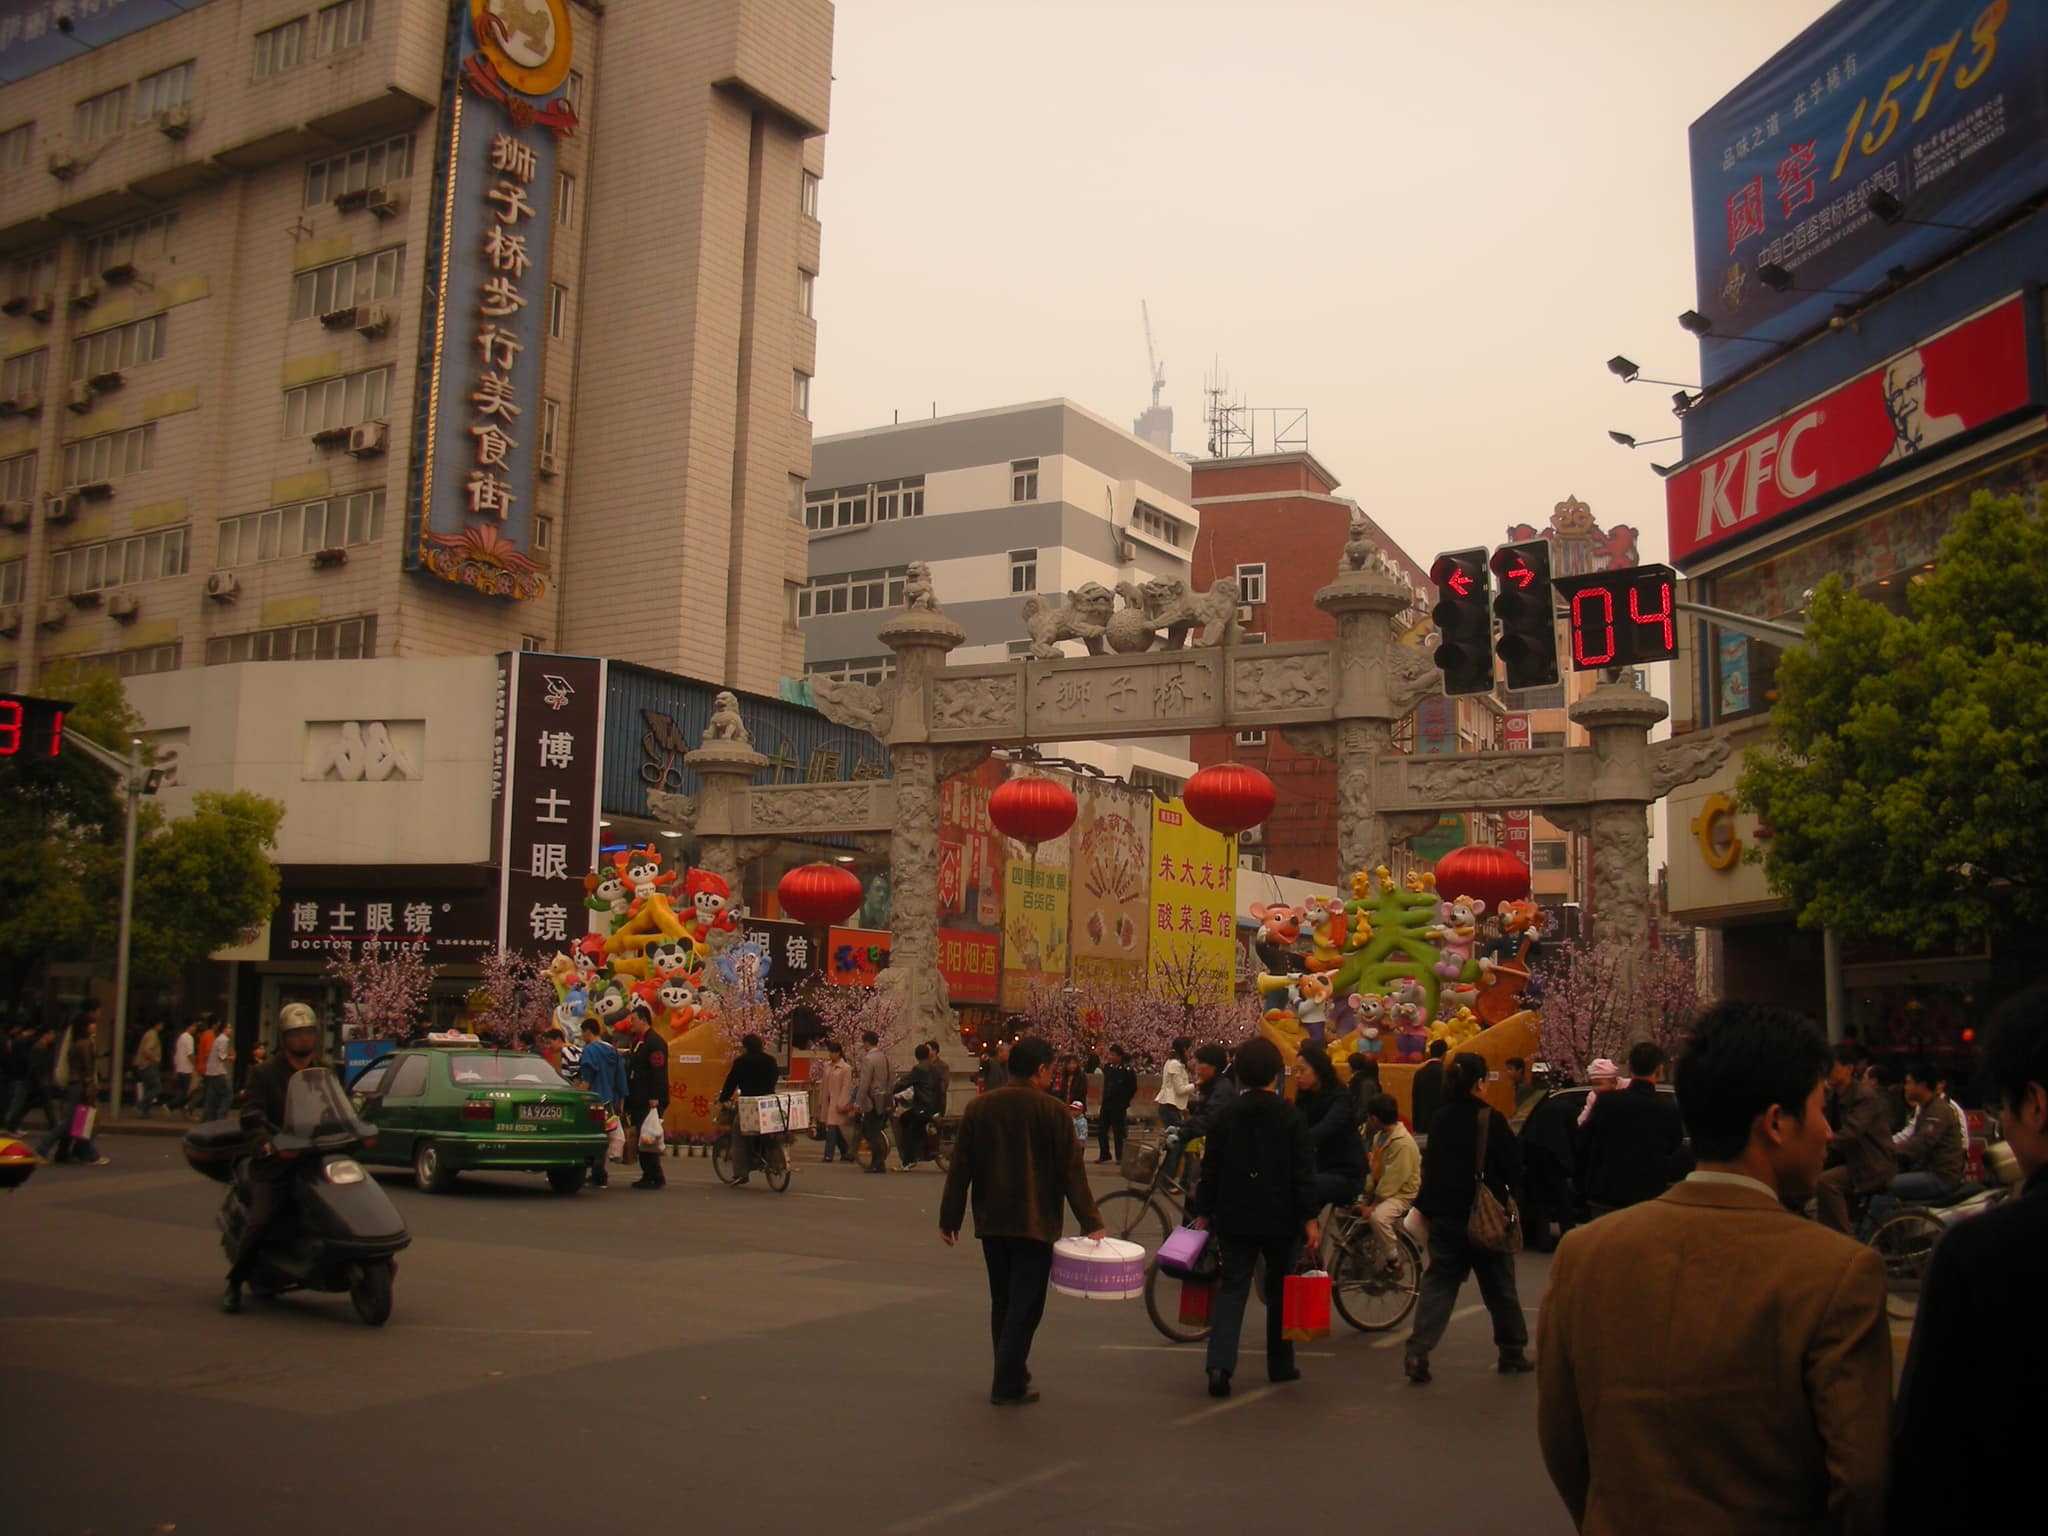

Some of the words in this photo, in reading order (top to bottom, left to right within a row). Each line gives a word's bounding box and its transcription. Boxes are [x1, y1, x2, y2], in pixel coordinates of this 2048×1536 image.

[1830, 0, 2009, 182] 1573
[467, 133, 539, 519] 狮子桥步行美食街
[1696, 410, 1818, 543] KFC
[1571, 582, 1672, 666] 04
[1056, 674, 1192, 718] 狮子桥
[530, 730, 575, 943] 博士眼镜
[291, 940, 352, 951] DOCTOR
[362, 940, 431, 952] OPTICAL
[292, 902, 433, 933] 博士眼镜
[1157, 903, 1231, 938] 酸菜鱼馆
